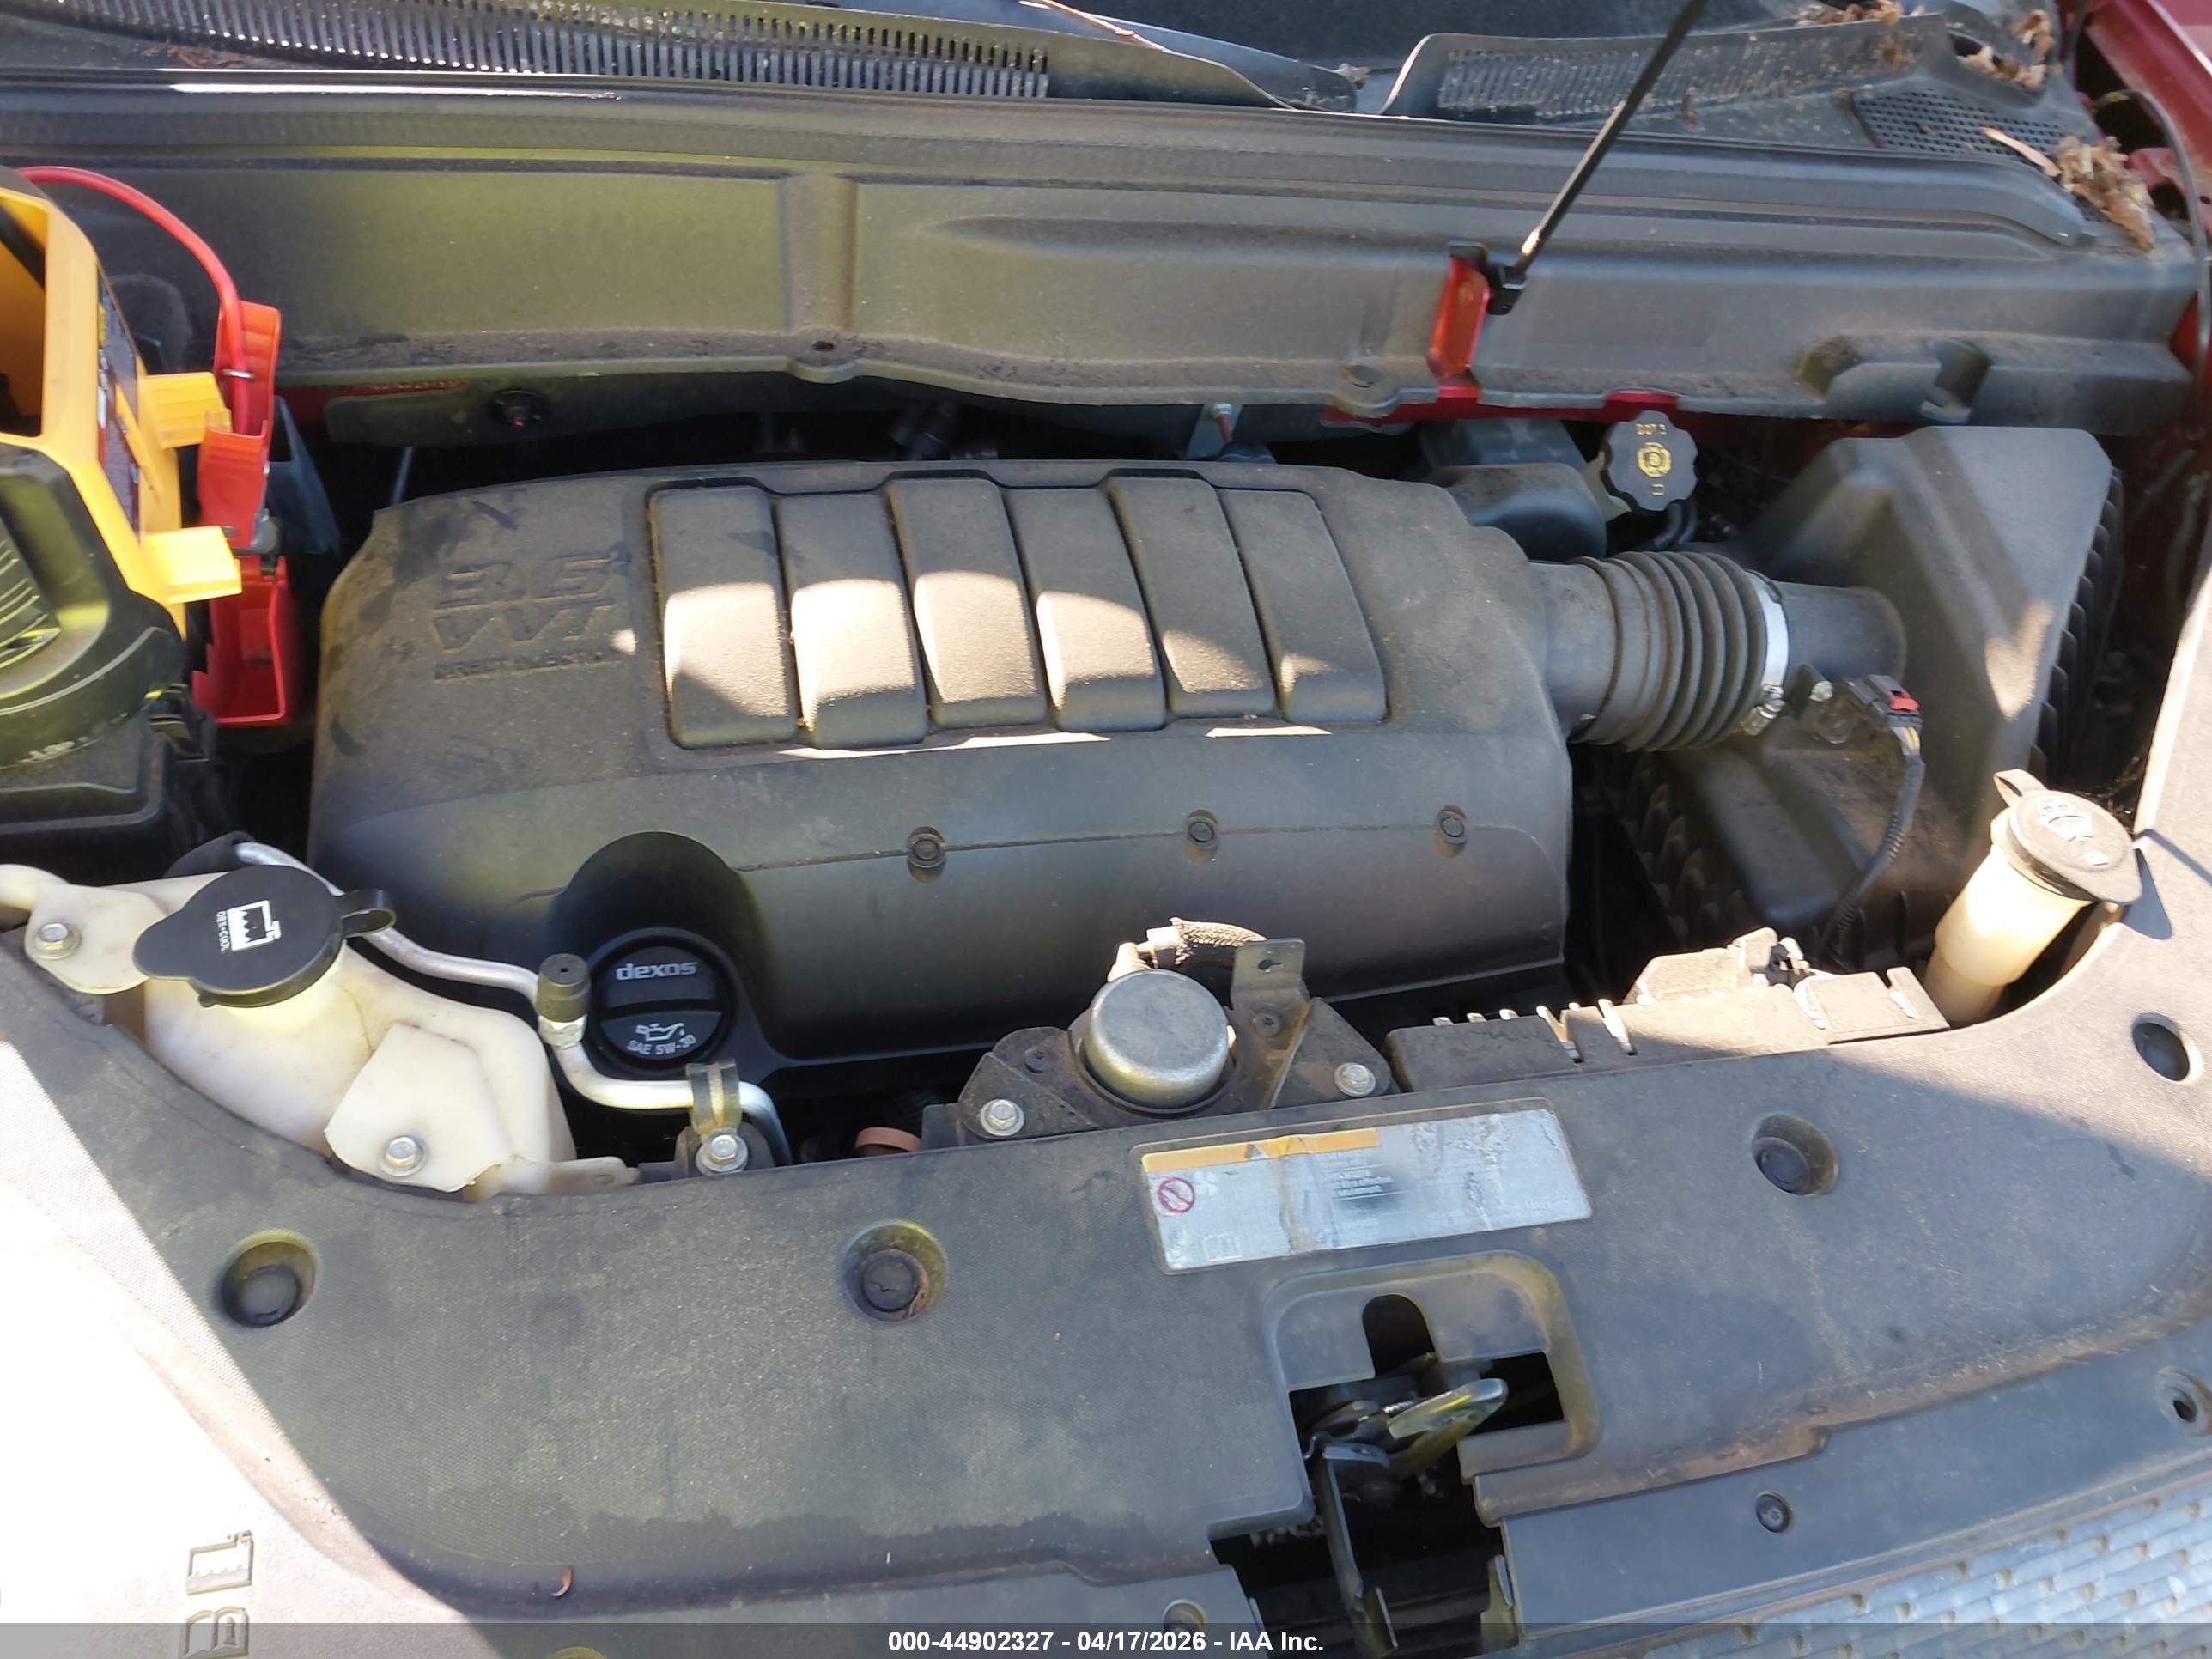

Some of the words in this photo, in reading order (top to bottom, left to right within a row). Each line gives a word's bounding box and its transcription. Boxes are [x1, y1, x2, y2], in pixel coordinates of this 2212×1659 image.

[616, 962, 698, 981] dexos
[627, 1040, 651, 1055] SAE
[655, 1035, 696, 1055] 5W-30
